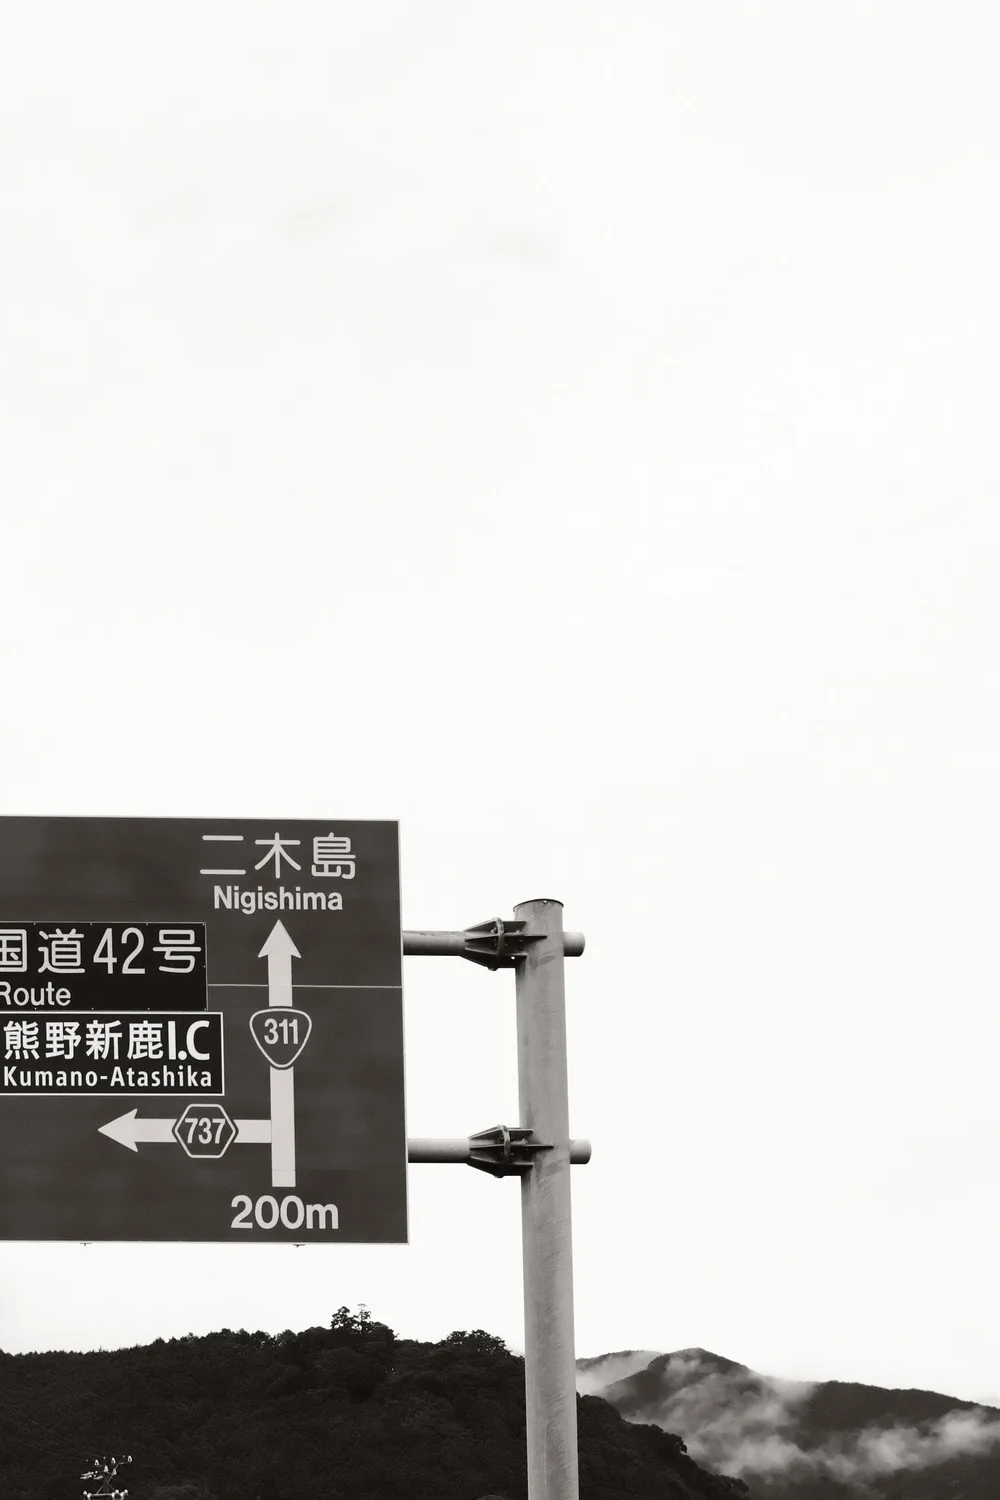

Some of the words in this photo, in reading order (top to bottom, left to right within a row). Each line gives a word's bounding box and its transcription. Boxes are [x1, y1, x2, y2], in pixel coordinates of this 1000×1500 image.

[200, 832, 356, 879] 二木島
[213, 886, 343, 914] Nigishima
[263, 1018, 299, 1045] 311
[3, 1065, 212, 1087] Kumano-Atashika
[184, 1117, 226, 1145] 737
[231, 1195, 339, 1229] 200m
